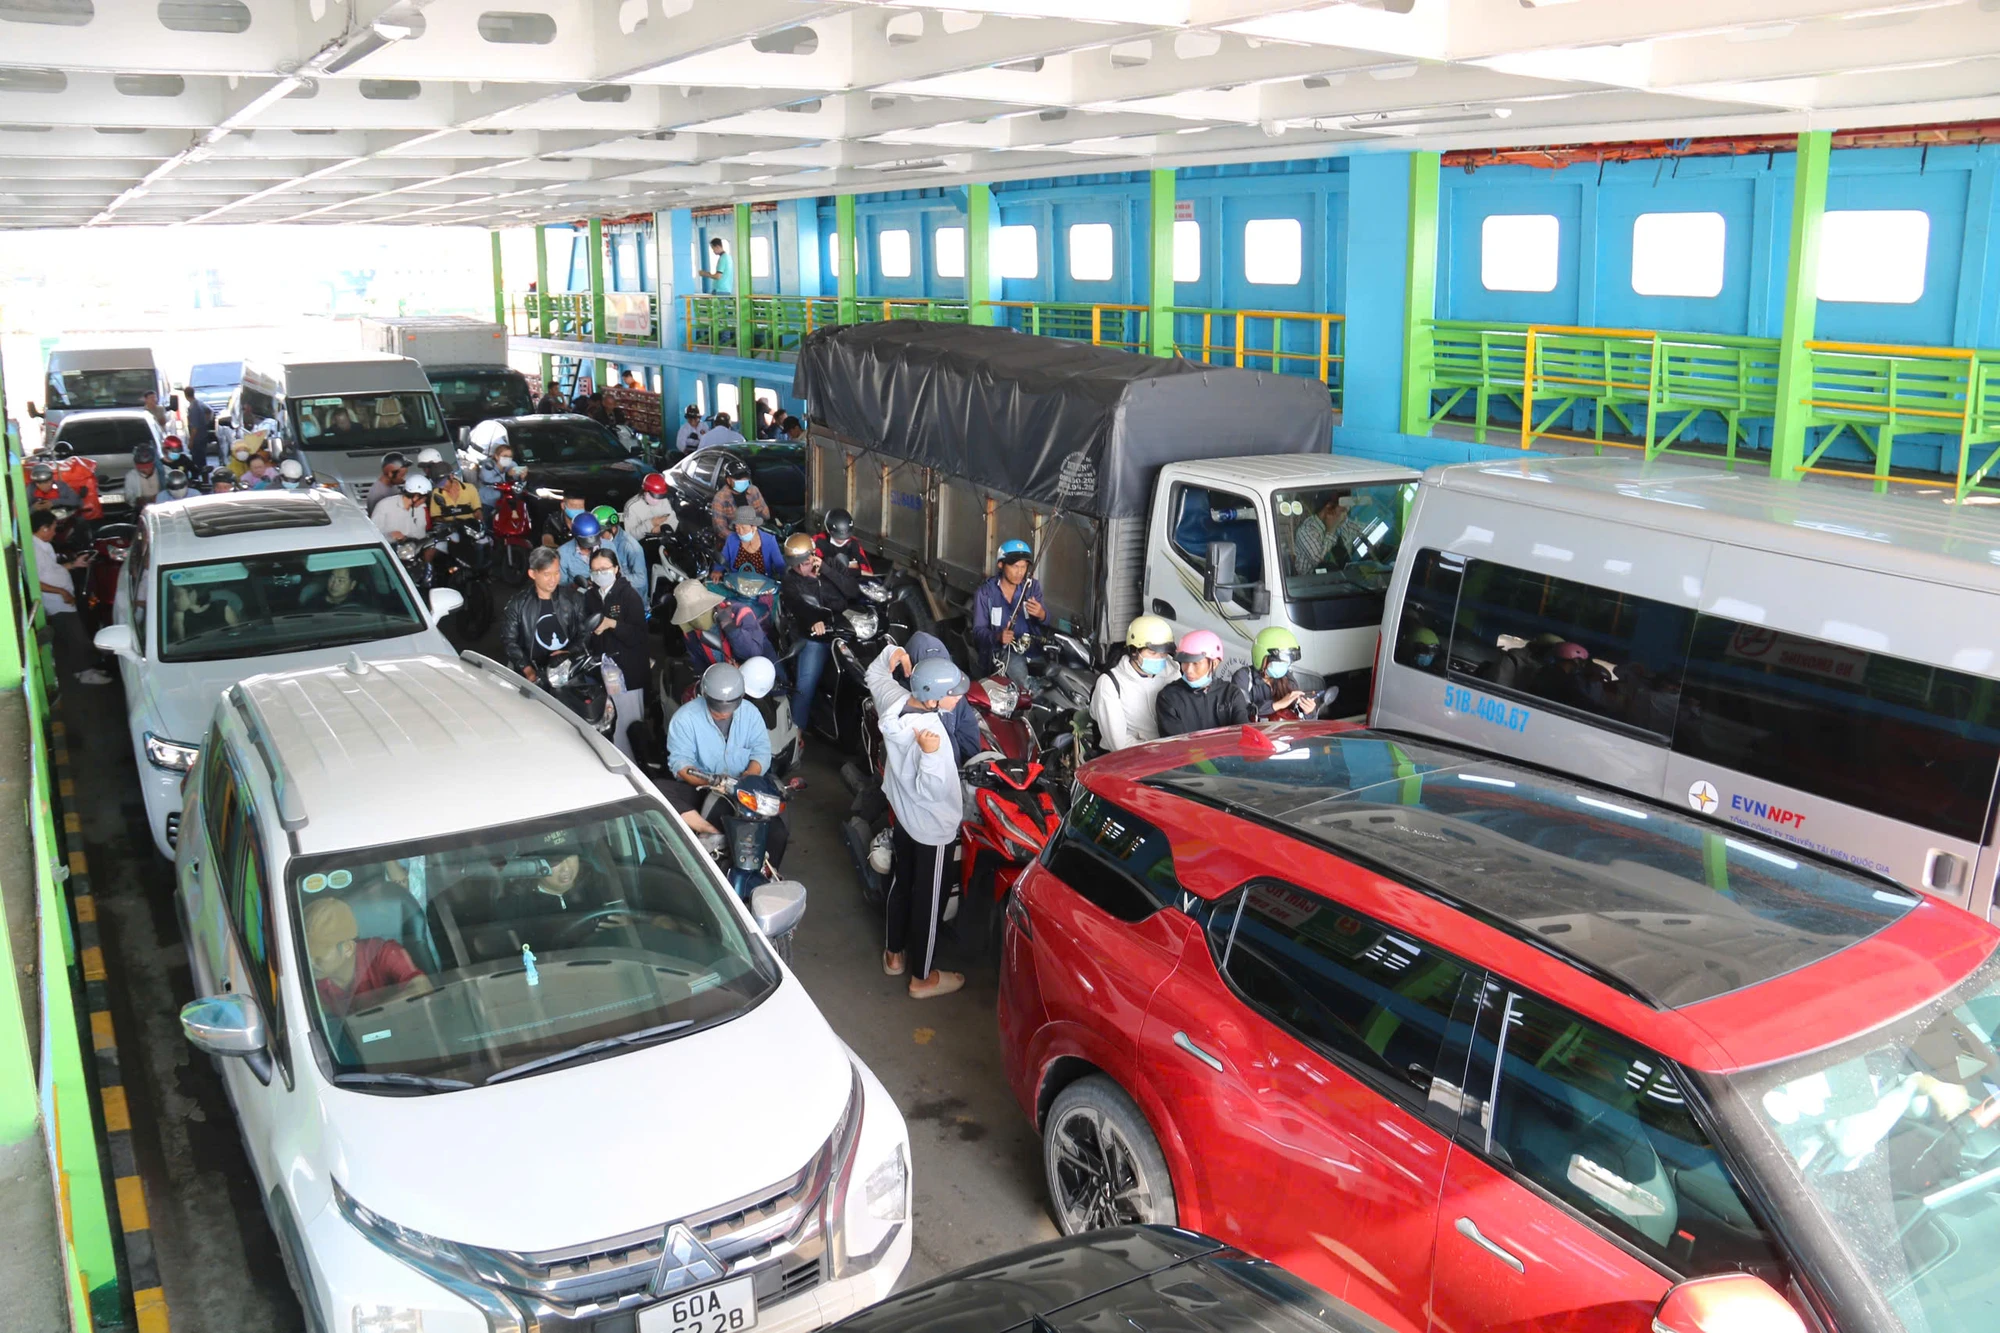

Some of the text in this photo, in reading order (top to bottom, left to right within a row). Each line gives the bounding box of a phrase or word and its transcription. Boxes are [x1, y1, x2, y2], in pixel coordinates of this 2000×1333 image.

[1444, 684, 1530, 733] 51B.409.67
[1731, 794, 1806, 829] EVNNPT
[1876, 862, 1890, 873] GIA
[672, 1290, 721, 1323] 60A
